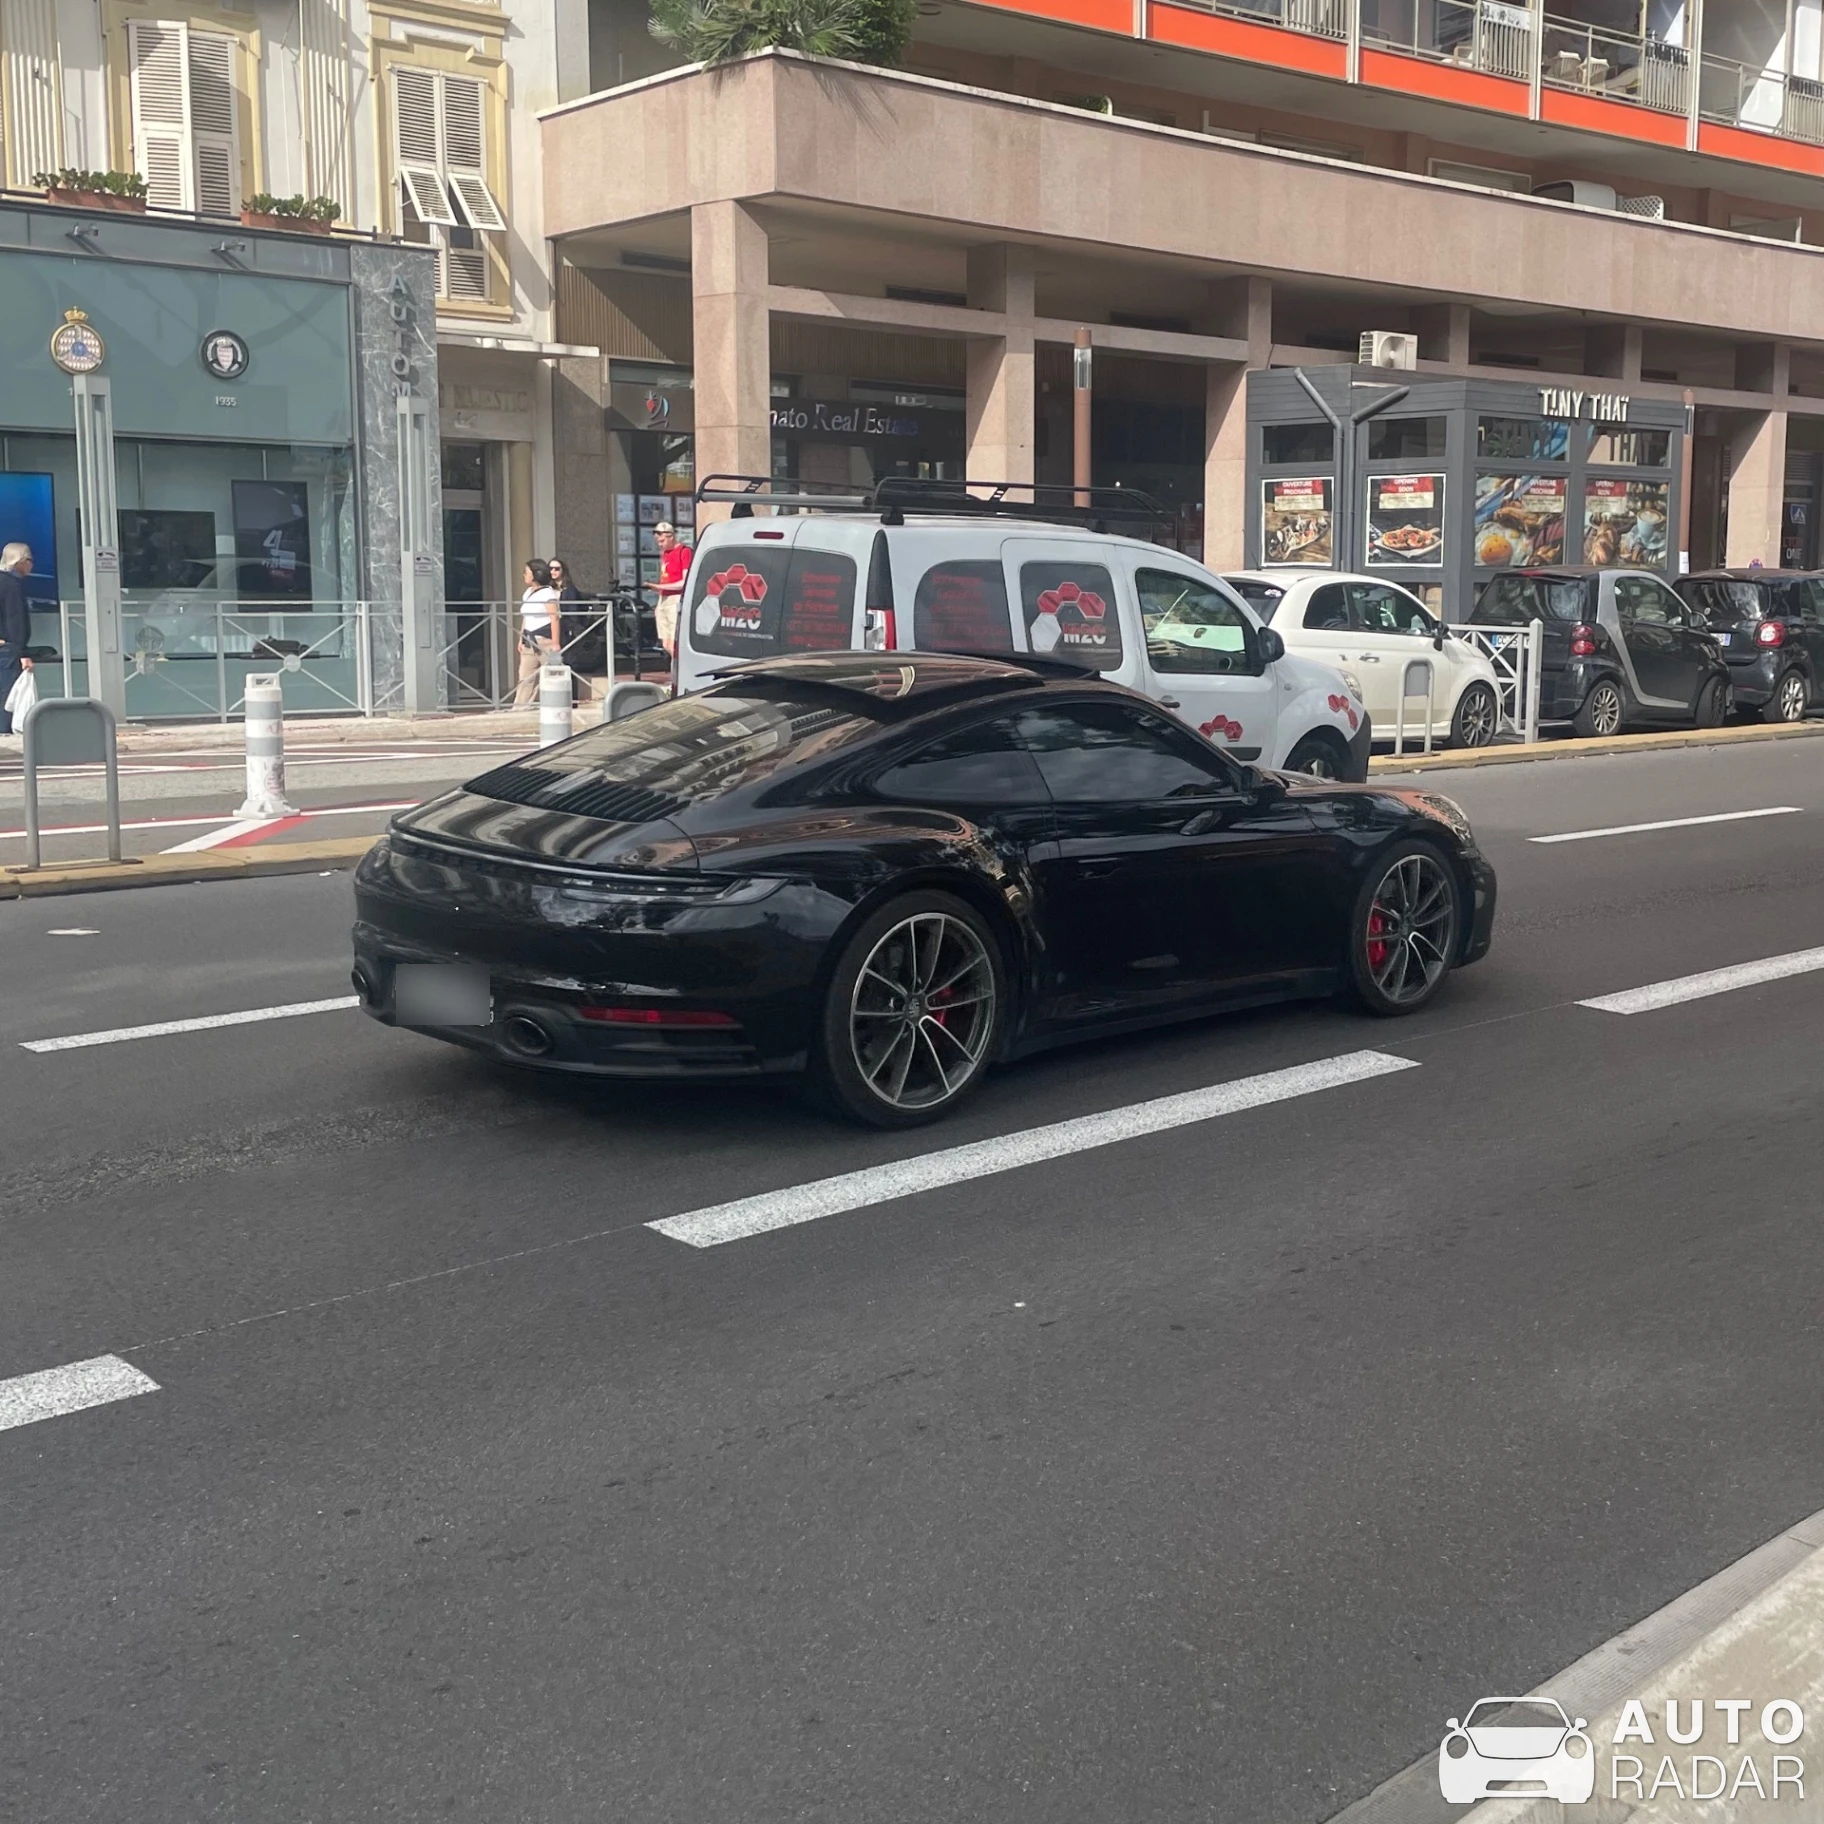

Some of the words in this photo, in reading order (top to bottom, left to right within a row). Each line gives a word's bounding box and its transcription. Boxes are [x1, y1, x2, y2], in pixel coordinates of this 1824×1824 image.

[215, 396, 237, 406] 1935
[813, 403, 860, 432] Real
[863, 407, 919, 437] Estate
[1398, 485, 1414, 493] SOON
